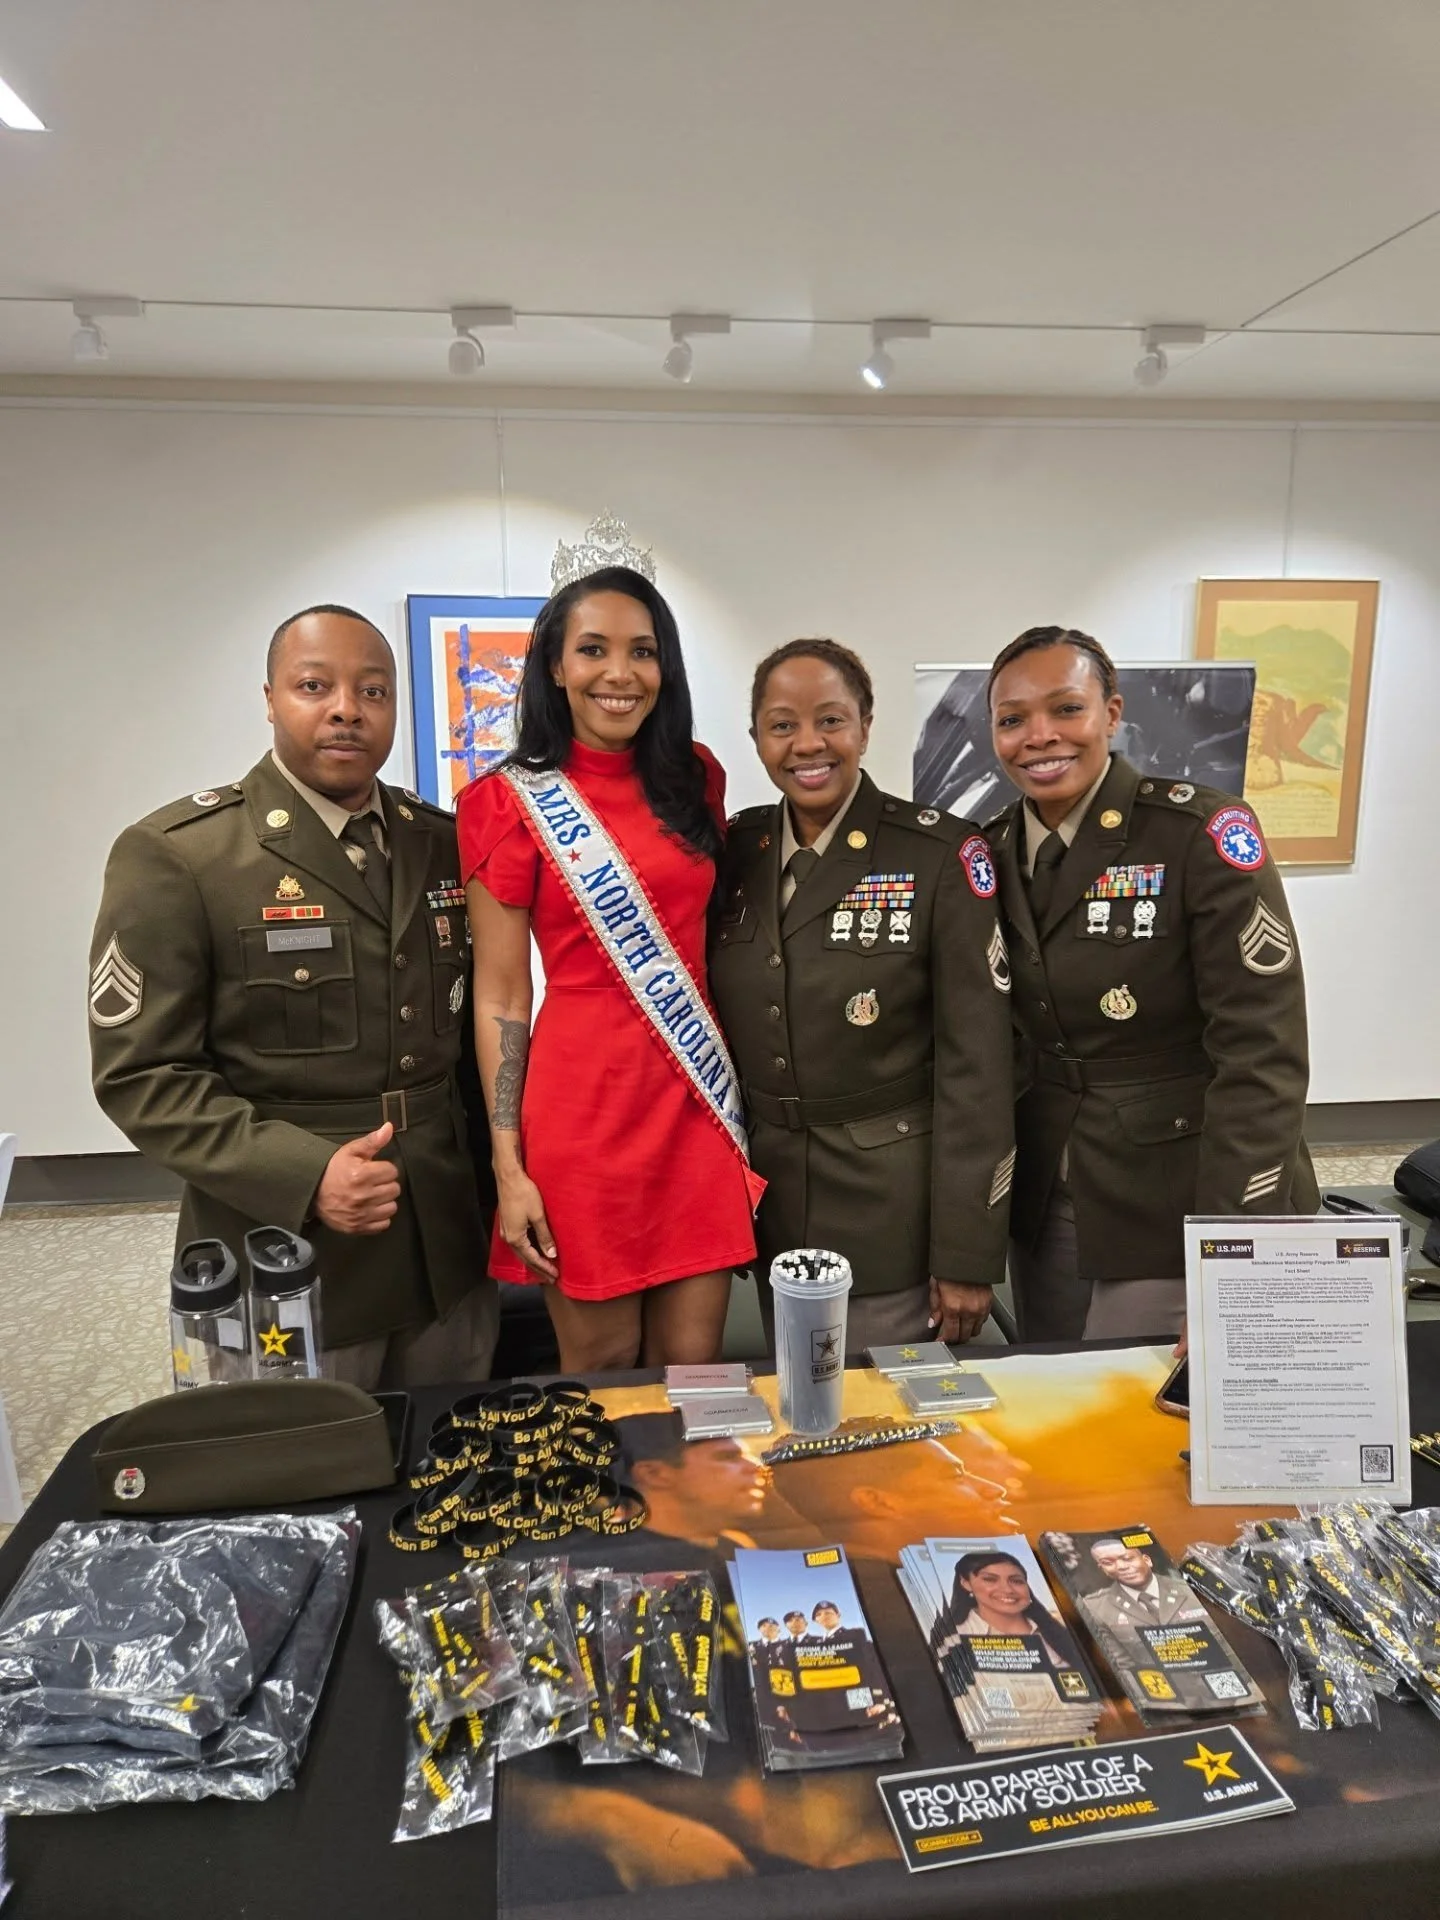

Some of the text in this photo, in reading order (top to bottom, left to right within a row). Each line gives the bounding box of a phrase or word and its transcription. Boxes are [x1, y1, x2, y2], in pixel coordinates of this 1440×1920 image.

[1212, 810, 1251, 833] RECRUITING
[529, 783, 734, 1110] MRS NORTH CAROLINA
[487, 1411, 500, 1422] All
[502, 1411, 526, 1423] You
[514, 1431, 530, 1444] Be
[533, 1427, 548, 1441] All
[518, 1446, 552, 1464] Be All
[572, 1447, 612, 1466] Can Be
[435, 1458, 450, 1470] Be
[453, 1458, 468, 1471] All
[514, 1466, 530, 1478] Be
[421, 1472, 444, 1487] You
[442, 1494, 461, 1512] Be
[460, 1511, 486, 1522] You
[488, 1500, 512, 1518] Can
[544, 1504, 558, 1516] All
[562, 1501, 585, 1514] You
[440, 1520, 457, 1533] Be
[513, 1517, 538, 1529] Can
[602, 1523, 627, 1535] You
[532, 1530, 556, 1540] Can
[396, 1536, 438, 1552] Can Be
[464, 1546, 480, 1558] Be
[484, 1542, 500, 1557] All
[898, 1753, 1154, 1811] PROUD PARENT OF A
[1203, 1780, 1260, 1803] U.S. ARMY
[906, 1774, 1147, 1831] U.S. ARMY SOLDIER
[1029, 1800, 1159, 1833] BE ALL YOU CAN BE.
